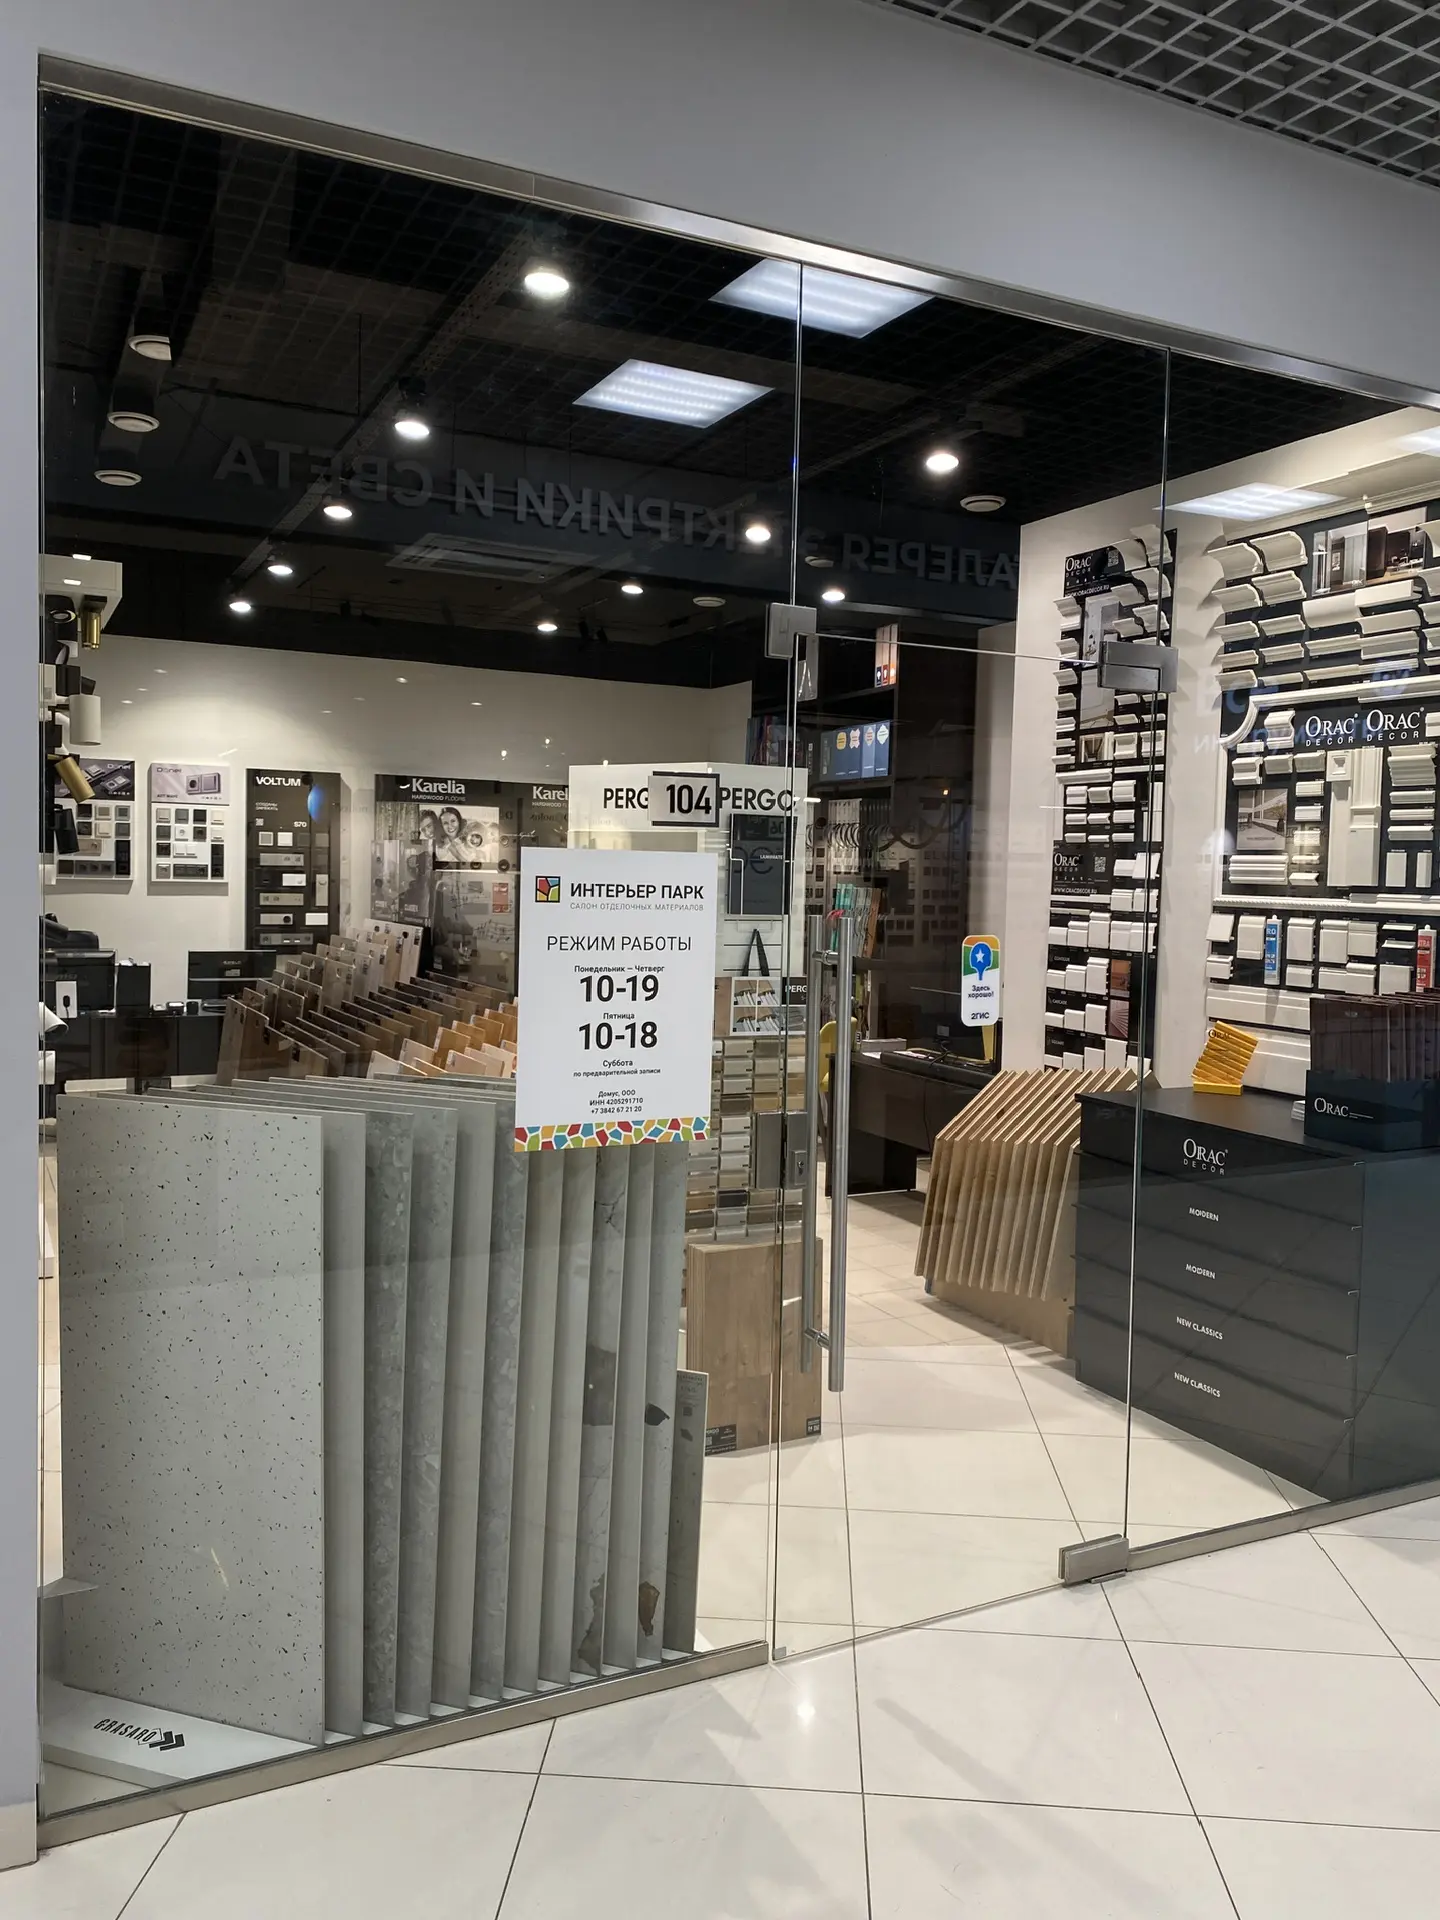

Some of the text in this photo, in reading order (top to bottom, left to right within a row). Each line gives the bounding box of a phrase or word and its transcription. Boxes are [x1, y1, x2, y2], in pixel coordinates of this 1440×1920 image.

[1066, 556, 1092, 571] ORAC
[1306, 709, 1421, 737] ORAC ORAC
[1306, 730, 1419, 747] DECOR DECOR
[255, 776, 301, 787] VOLTUM
[412, 779, 466, 794] Karelia
[666, 784, 712, 815] 104
[719, 787, 797, 812] PERGO
[1054, 853, 1080, 867] ORAC
[570, 883, 704, 900] ИНТЕРЬЕР ПАРК
[570, 902, 704, 912] САЛОН ОТДЕЛОЧНЫХ МАТЕРИАЛОВ
[547, 936, 691, 951] РЕЖИМ РАБОТЫ
[574, 965, 625, 973] Понедельник
[634, 965, 665, 973] Четверг
[580, 974, 659, 1002] 10-19
[968, 991, 994, 999] хорошо!
[603, 1012, 635, 1020] Пятница
[971, 1012, 990, 1020] 2ГИС
[579, 1021, 658, 1050] 10-18
[602, 1059, 634, 1068] Суббота
[583, 1069, 638, 1078] предварительной
[598, 1090, 621, 1098] Домус,
[606, 1097, 644, 1105] 4205291710
[1314, 1097, 1349, 1117] ORAC
[1183, 1138, 1226, 1166] ORAC
[1183, 1158, 1225, 1175] DECOR
[1189, 1207, 1219, 1222] MODERN
[1185, 1263, 1216, 1280] MODERN
[1176, 1316, 1223, 1340] NEW CLASSICS
[1174, 1371, 1221, 1398] NEW CLASSICS
[94, 1718, 157, 1742] GRASARO
